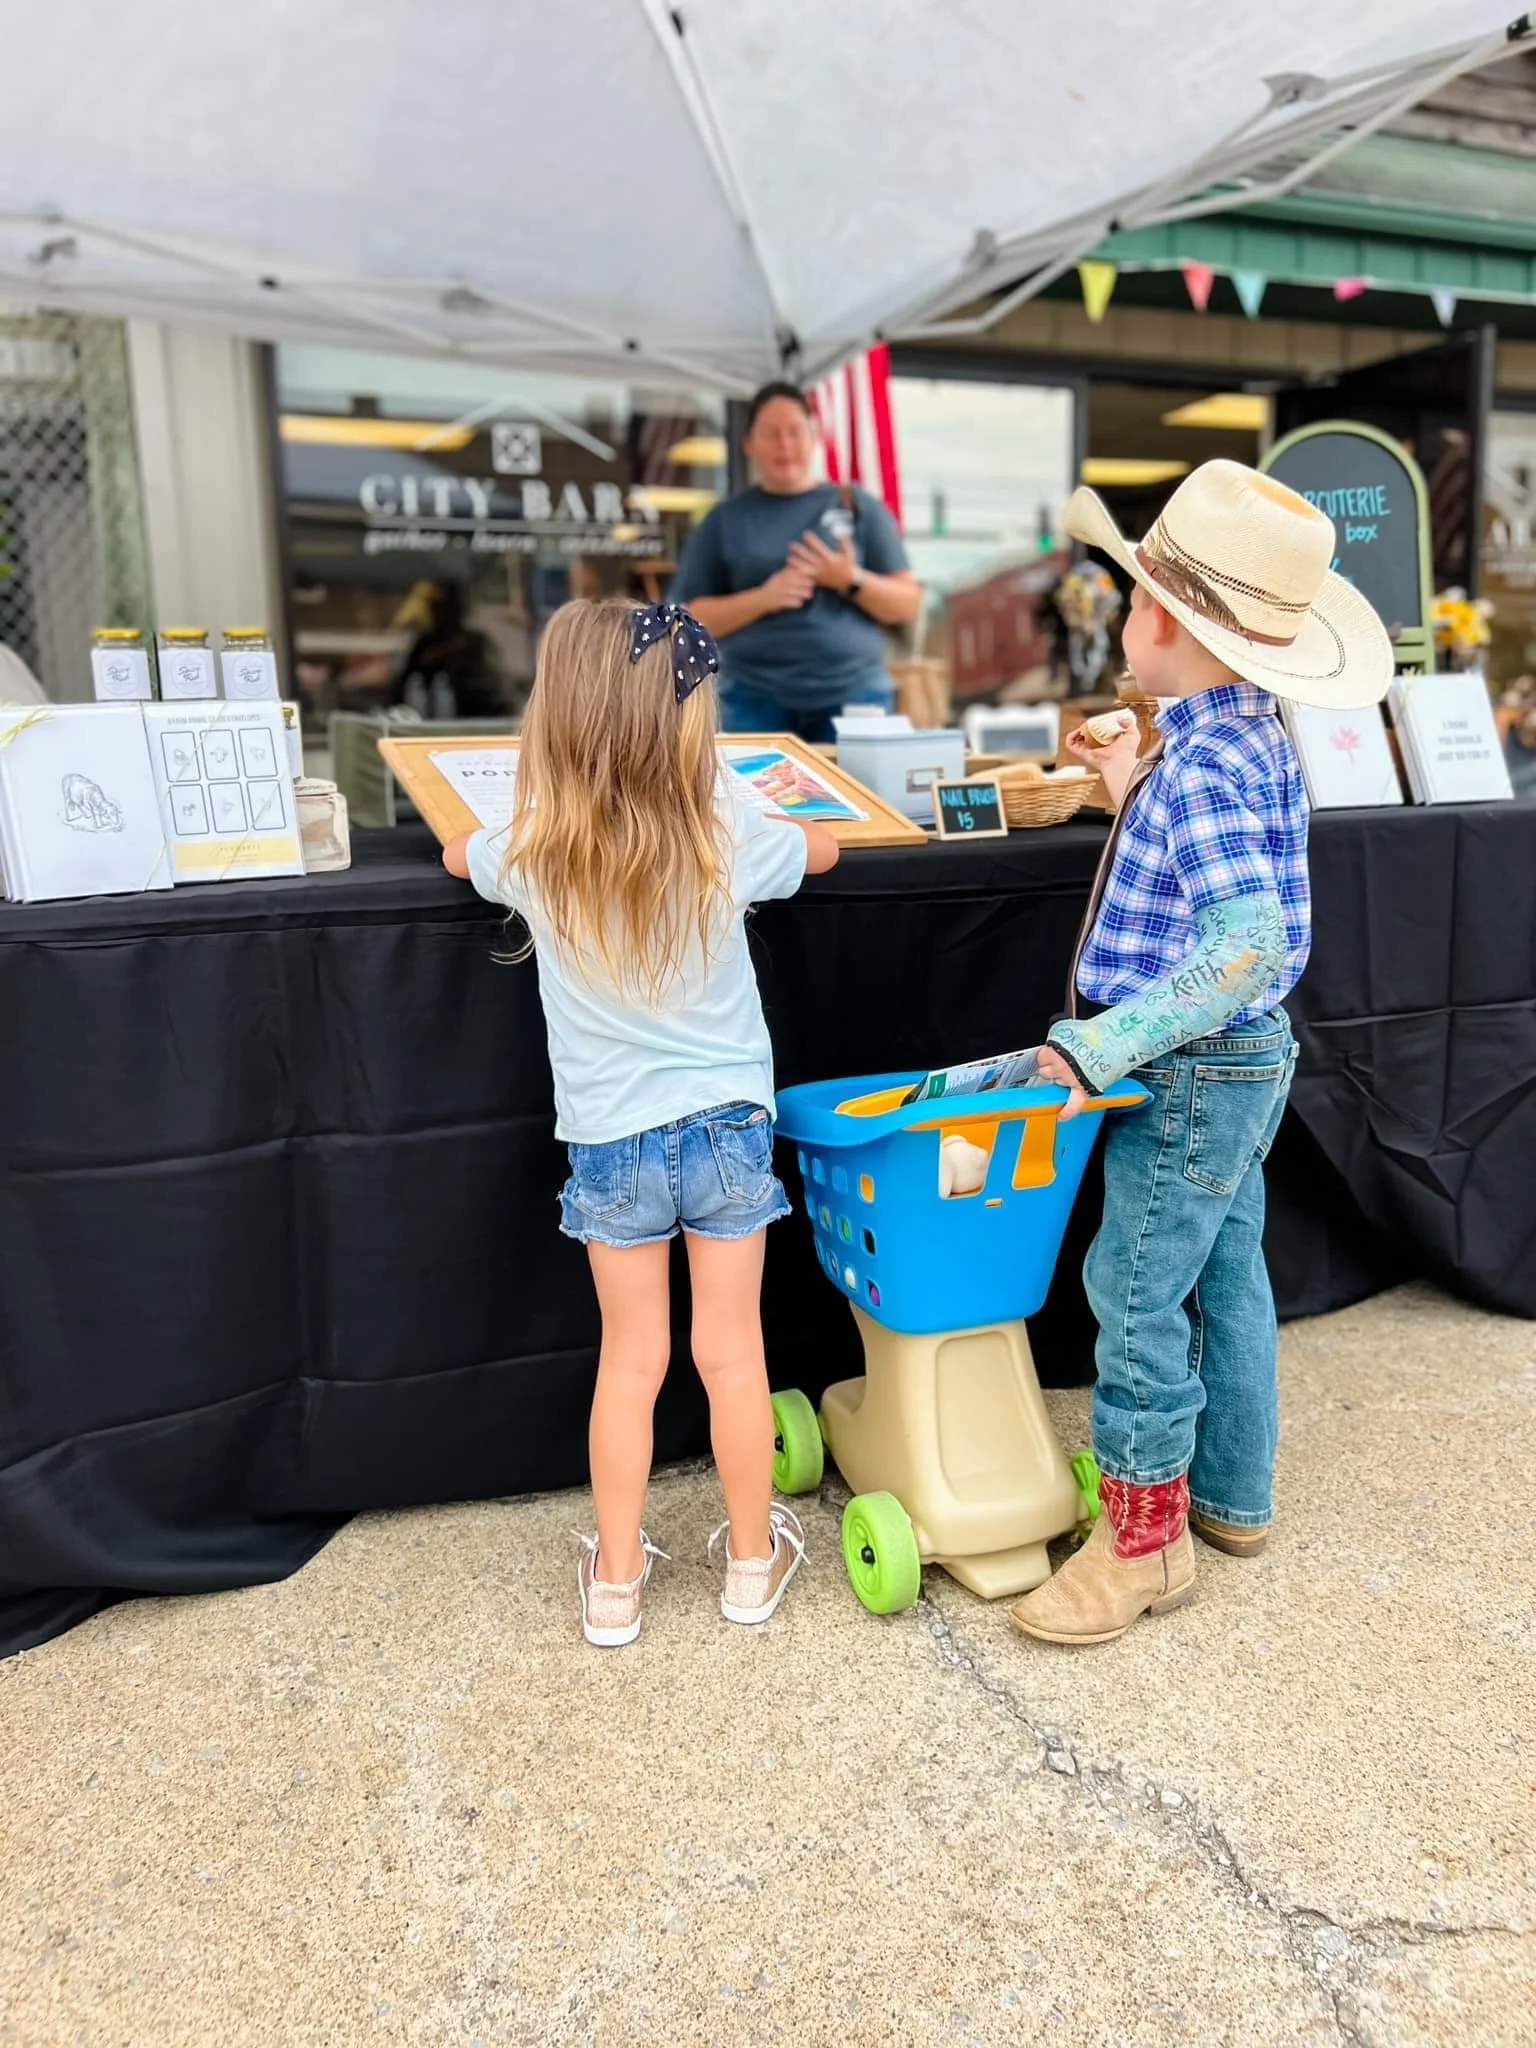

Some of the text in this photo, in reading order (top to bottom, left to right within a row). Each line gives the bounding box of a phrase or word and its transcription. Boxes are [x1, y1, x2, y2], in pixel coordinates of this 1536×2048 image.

[360, 474, 660, 523] CITY BARN
[1345, 521, 1378, 544] box
[1068, 1031, 1102, 1071] MOM
[1138, 1028, 1193, 1063] NORA
